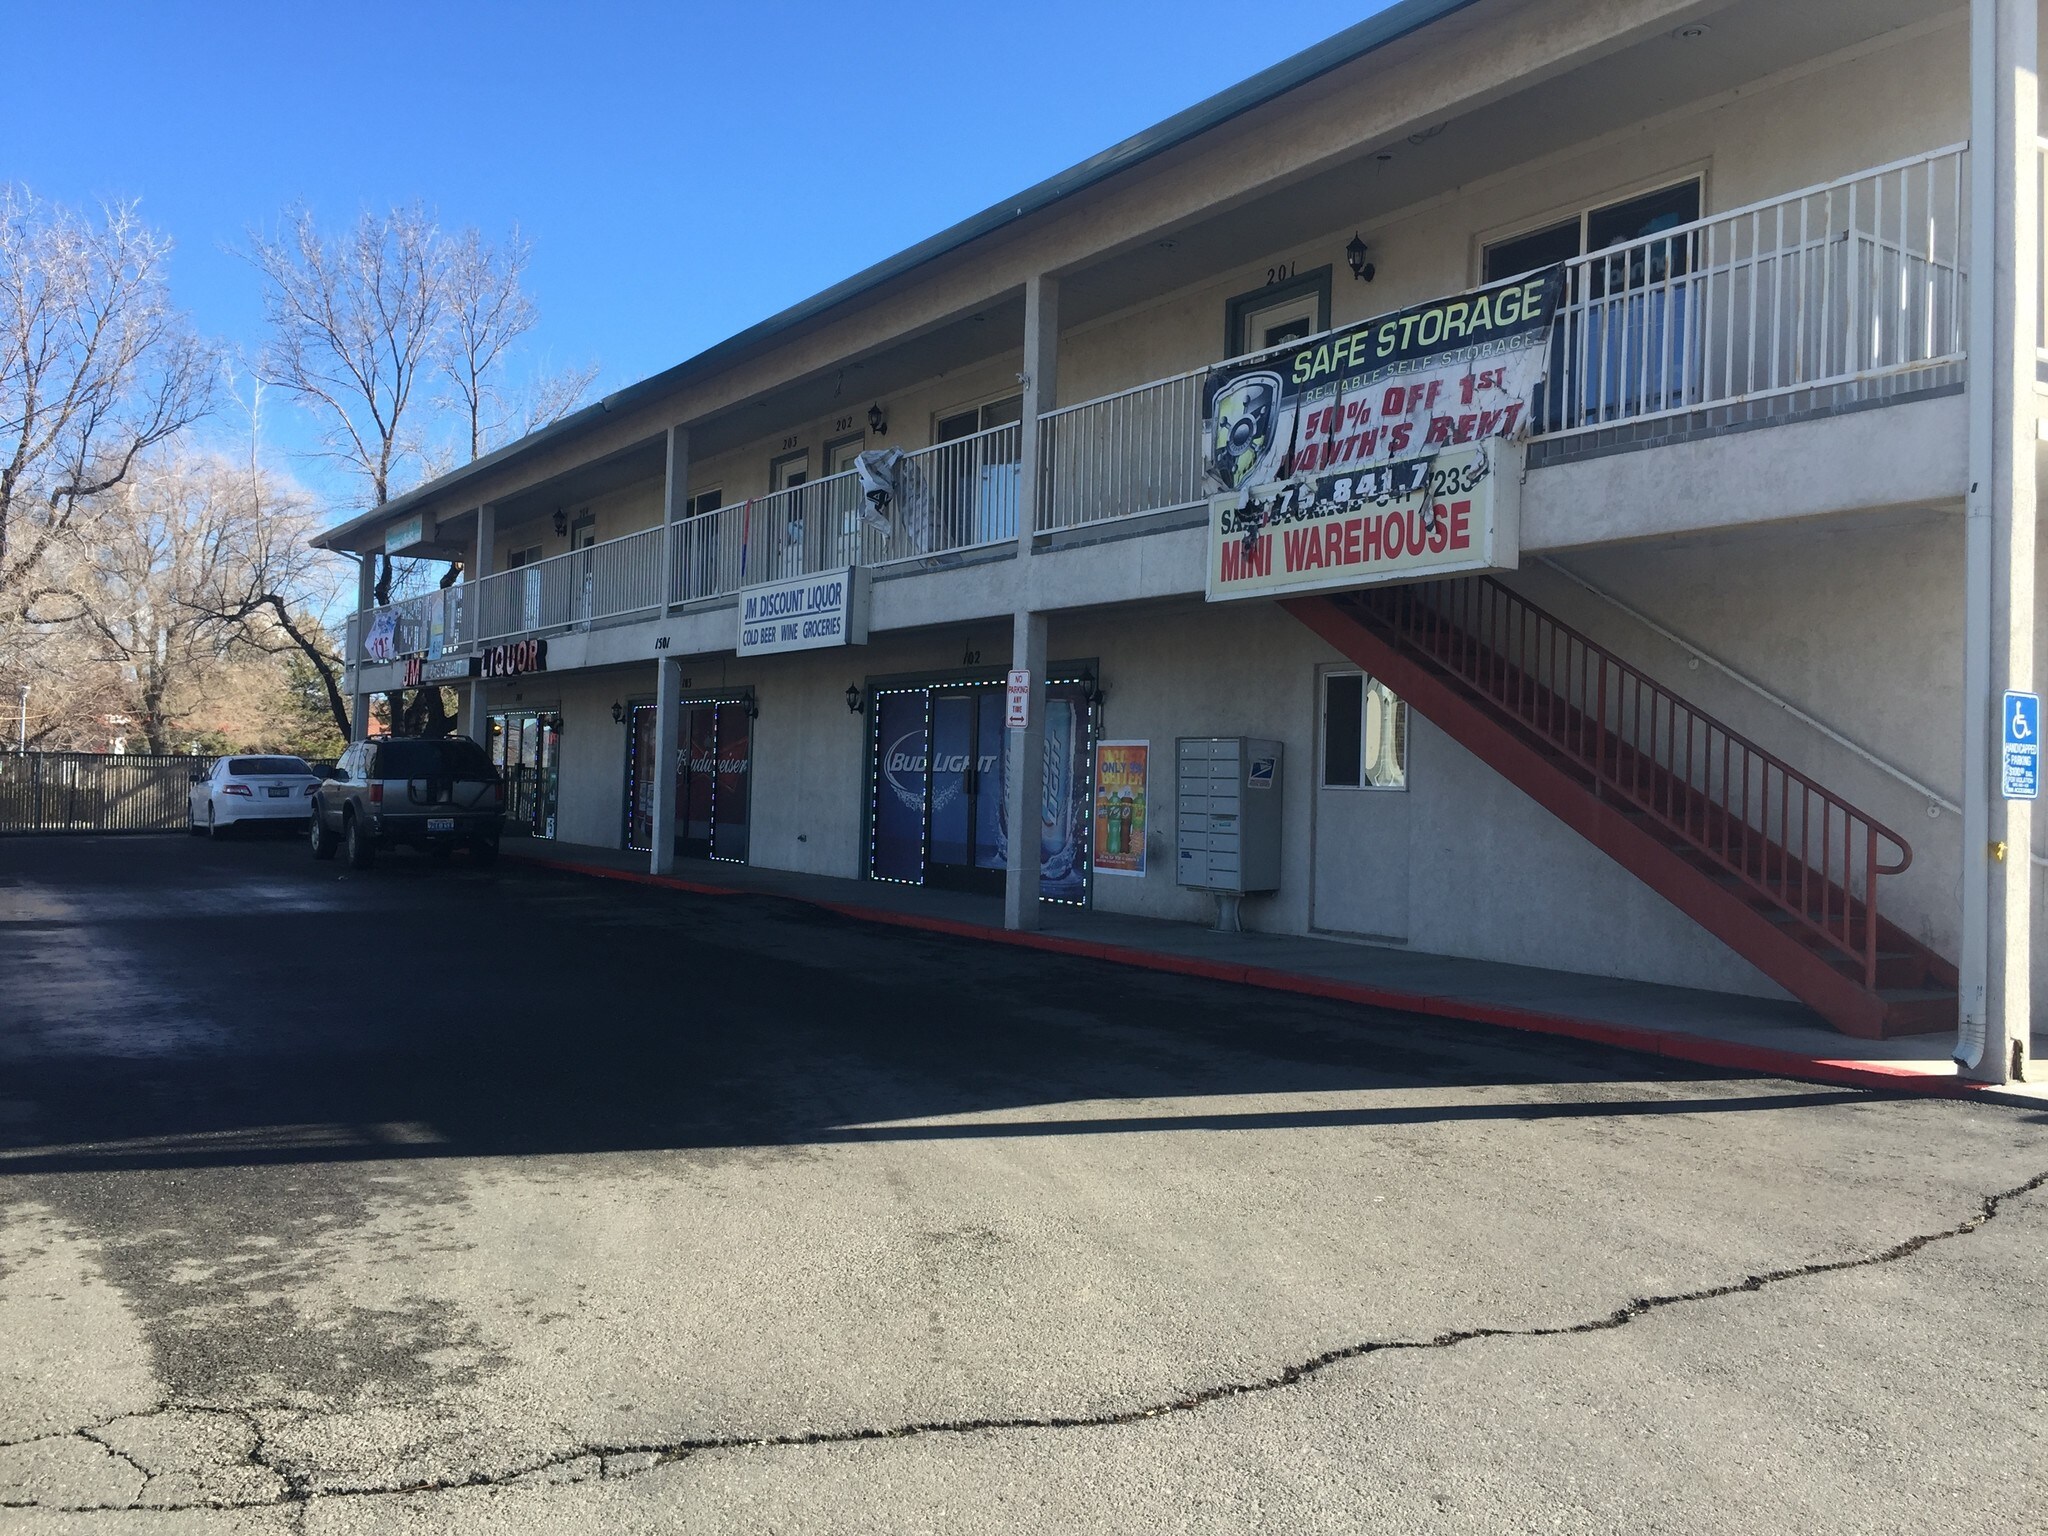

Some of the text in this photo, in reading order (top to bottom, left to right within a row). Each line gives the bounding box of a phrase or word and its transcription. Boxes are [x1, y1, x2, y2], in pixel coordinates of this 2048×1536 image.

[1266, 260, 1296, 286] 201
[1292, 278, 1545, 385] SAFE STORAGE
[1306, 330, 1534, 401] RELIABLE SELF STORAGE
[1380, 379, 1444, 416] OFF
[1459, 366, 1506, 405] 1ST
[836, 416, 853, 432] 202
[782, 436, 798, 450] 203
[1220, 533, 1273, 583] MINI
[1283, 500, 1472, 572] WAREHOUSE
[744, 581, 843, 620] JM DISCOUNT LIQUOR
[742, 616, 841, 647] COLD BEER WINE GROCERIES
[654, 636, 671, 650] 1501
[402, 657, 421, 687] JM
[480, 638, 540, 679] LIQUOR
[963, 650, 981, 665] 102
[1015, 674, 1023, 684] NO
[1008, 685, 1029, 695] PARKING
[1013, 696, 1022, 704] ANY
[1012, 705, 1023, 714] TIME
[889, 752, 999, 773] BUD LIGHT
[1101, 761, 1127, 774] ONLY
[2010, 754, 2033, 767] PARKING
